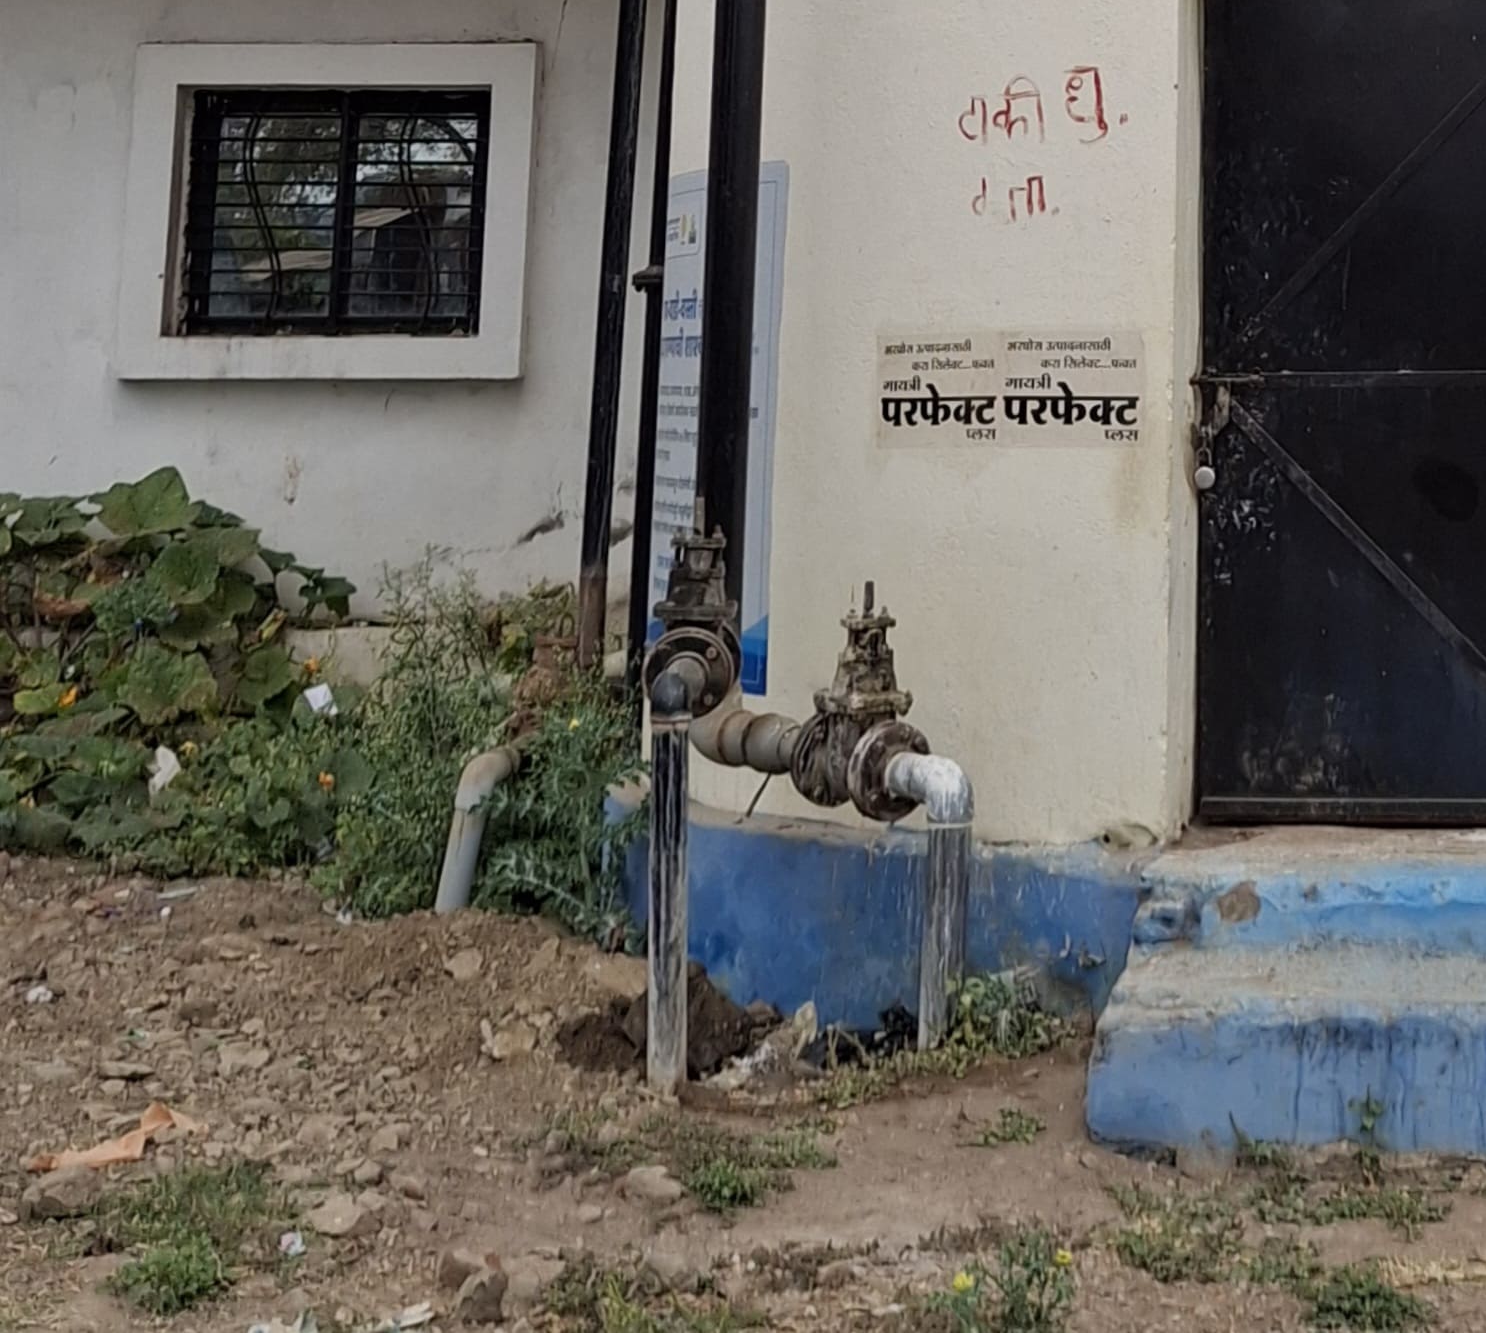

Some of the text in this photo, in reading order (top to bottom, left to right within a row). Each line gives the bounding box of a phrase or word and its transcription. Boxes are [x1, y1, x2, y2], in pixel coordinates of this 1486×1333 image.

[1046, 337, 1111, 352] उत्पादनासाठी
[883, 375, 921, 392] गायत्री
[1004, 372, 1051, 390] गायत्री
[881, 383, 997, 427] परफेक्ट
[1003, 381, 1139, 426] परफेक्ट
[1104, 429, 1139, 442] प्लस
